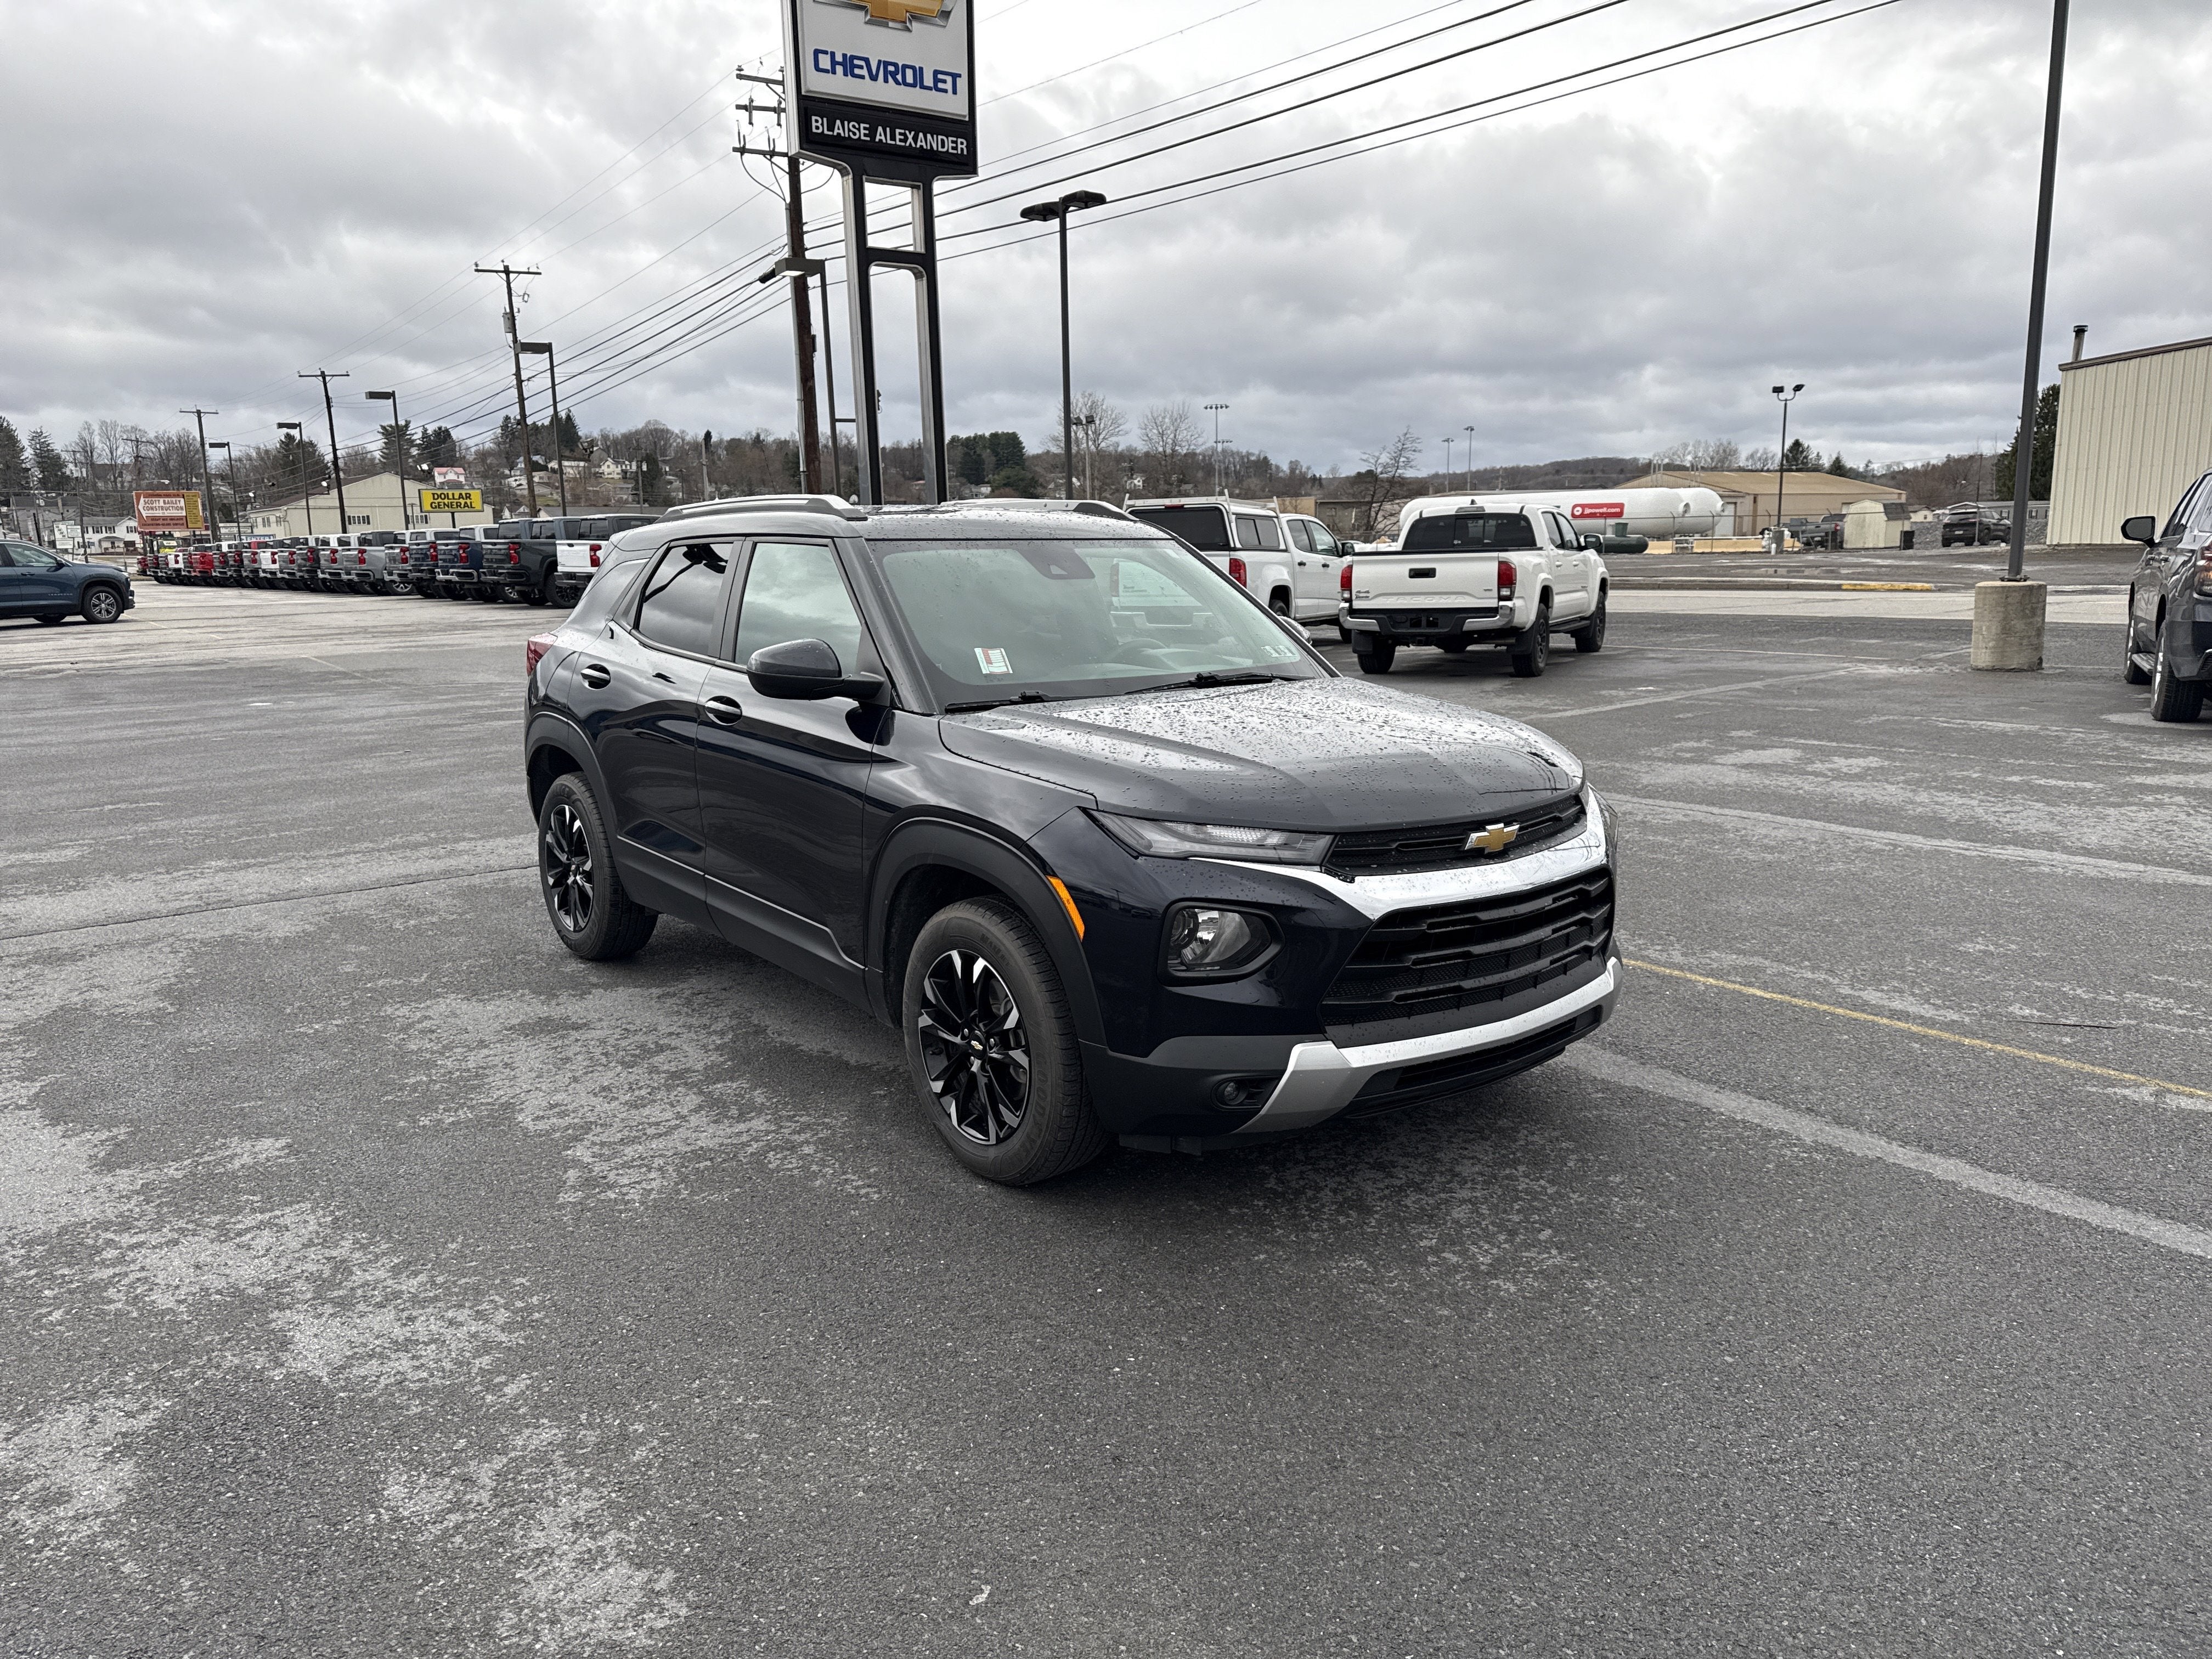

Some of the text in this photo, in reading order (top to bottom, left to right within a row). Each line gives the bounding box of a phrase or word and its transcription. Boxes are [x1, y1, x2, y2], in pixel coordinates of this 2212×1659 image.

[813, 48, 962, 95] CHEVROLET
[811, 115, 967, 155] BLAISE ALEXANDER
[430, 501, 476, 509] GENERAL
[431, 492, 472, 500] DOLLAR
